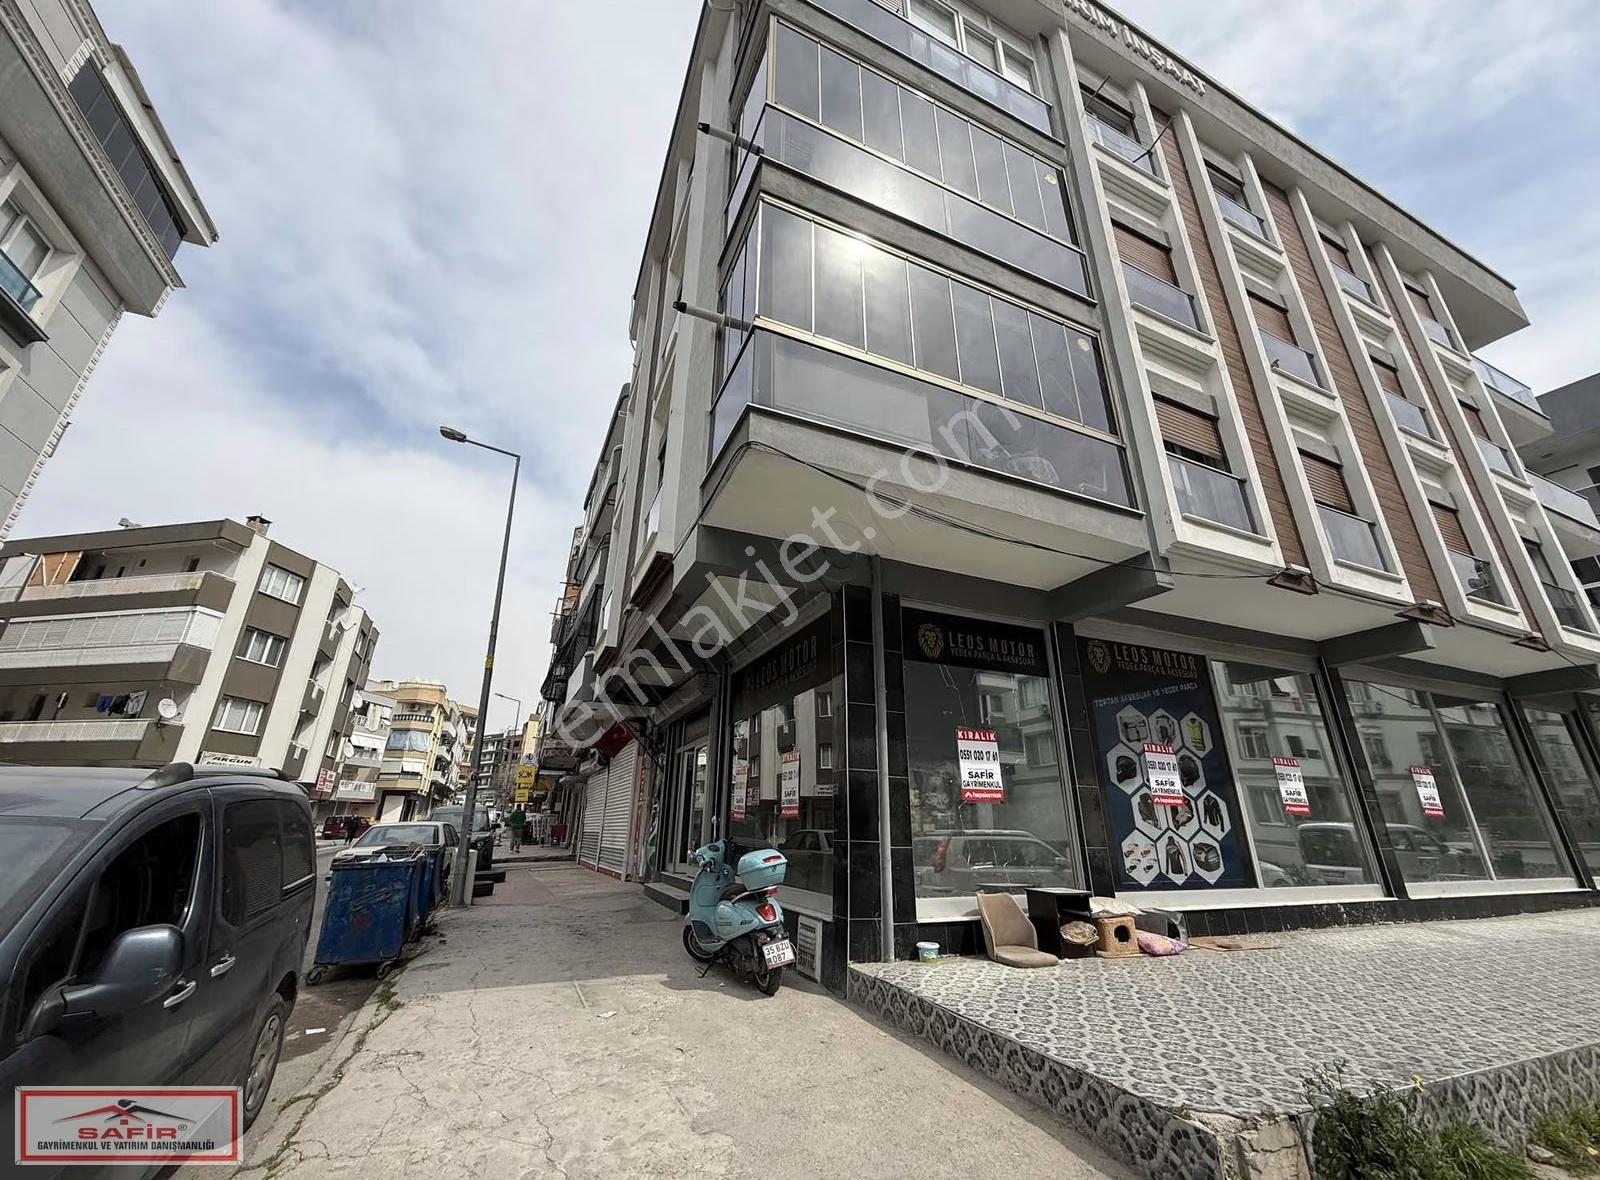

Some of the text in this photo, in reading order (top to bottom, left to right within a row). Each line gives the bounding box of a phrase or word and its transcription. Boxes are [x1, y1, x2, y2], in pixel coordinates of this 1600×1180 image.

[1064, 0, 1207, 97] RIM İNŞAAT
[948, 631, 1035, 658] LEOS MOTOR
[1113, 644, 1197, 671] LEOS MOTOR
[960, 749, 973, 761] 0551
[973, 749, 984, 761] 020
[967, 769, 994, 779] SAFİR
[1155, 778, 1175, 787] SAFİR
[765, 945, 776, 956] 35
